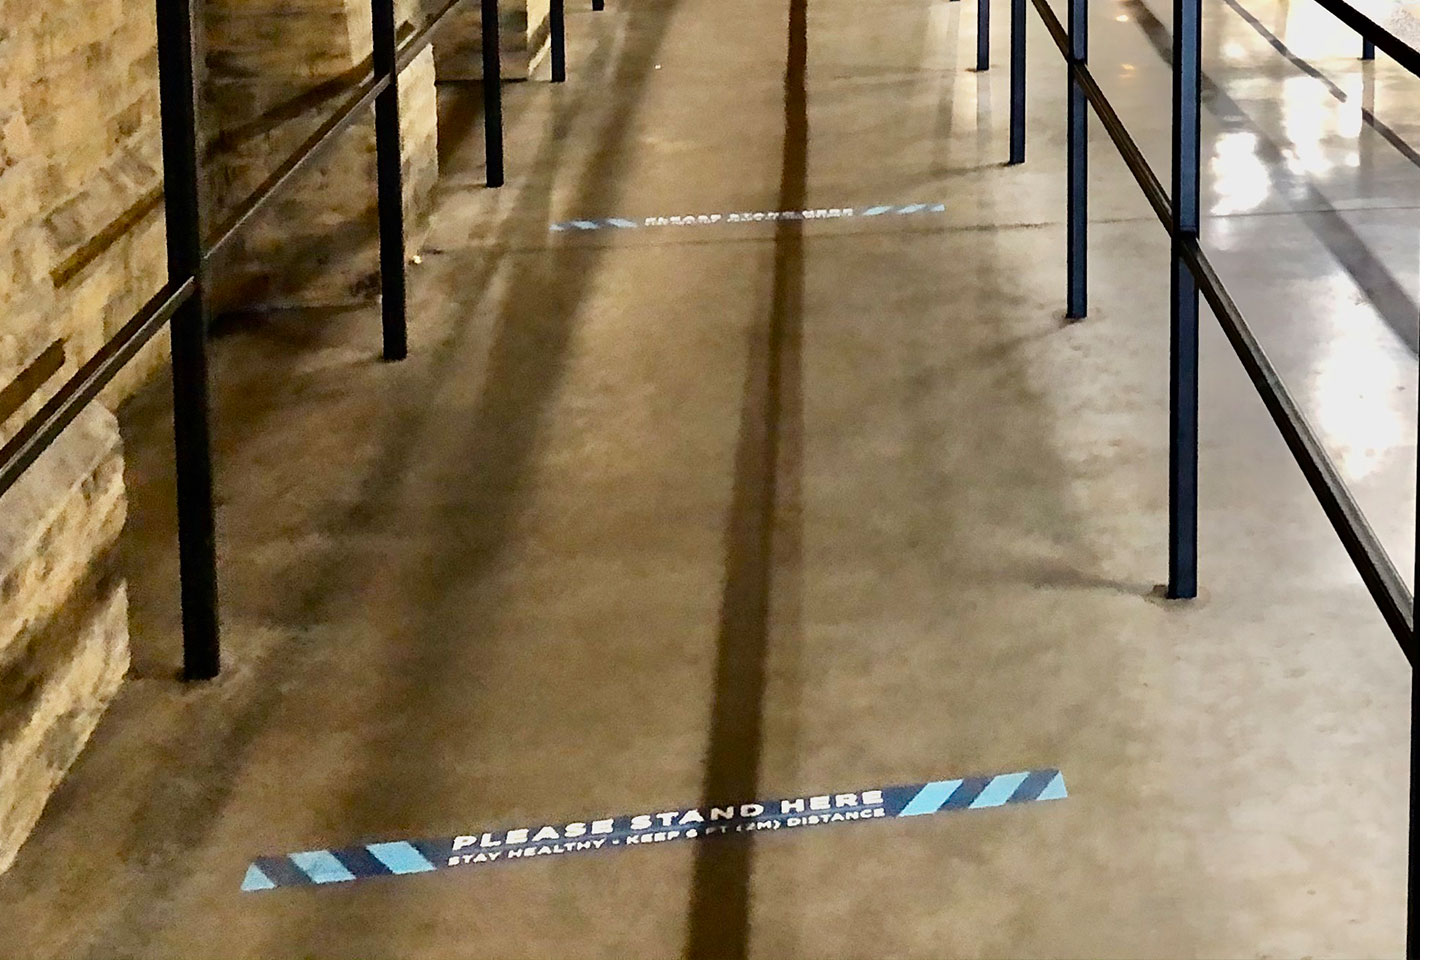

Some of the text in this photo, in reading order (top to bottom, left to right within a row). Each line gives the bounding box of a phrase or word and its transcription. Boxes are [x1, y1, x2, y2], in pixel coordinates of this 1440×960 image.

[448, 851, 501, 866] STAY
[508, 838, 608, 859] HEALTHY
[626, 830, 680, 845] KEEP
[787, 808, 886, 827] DISTANCE
[452, 790, 884, 851] PLEASE STAND HERE
